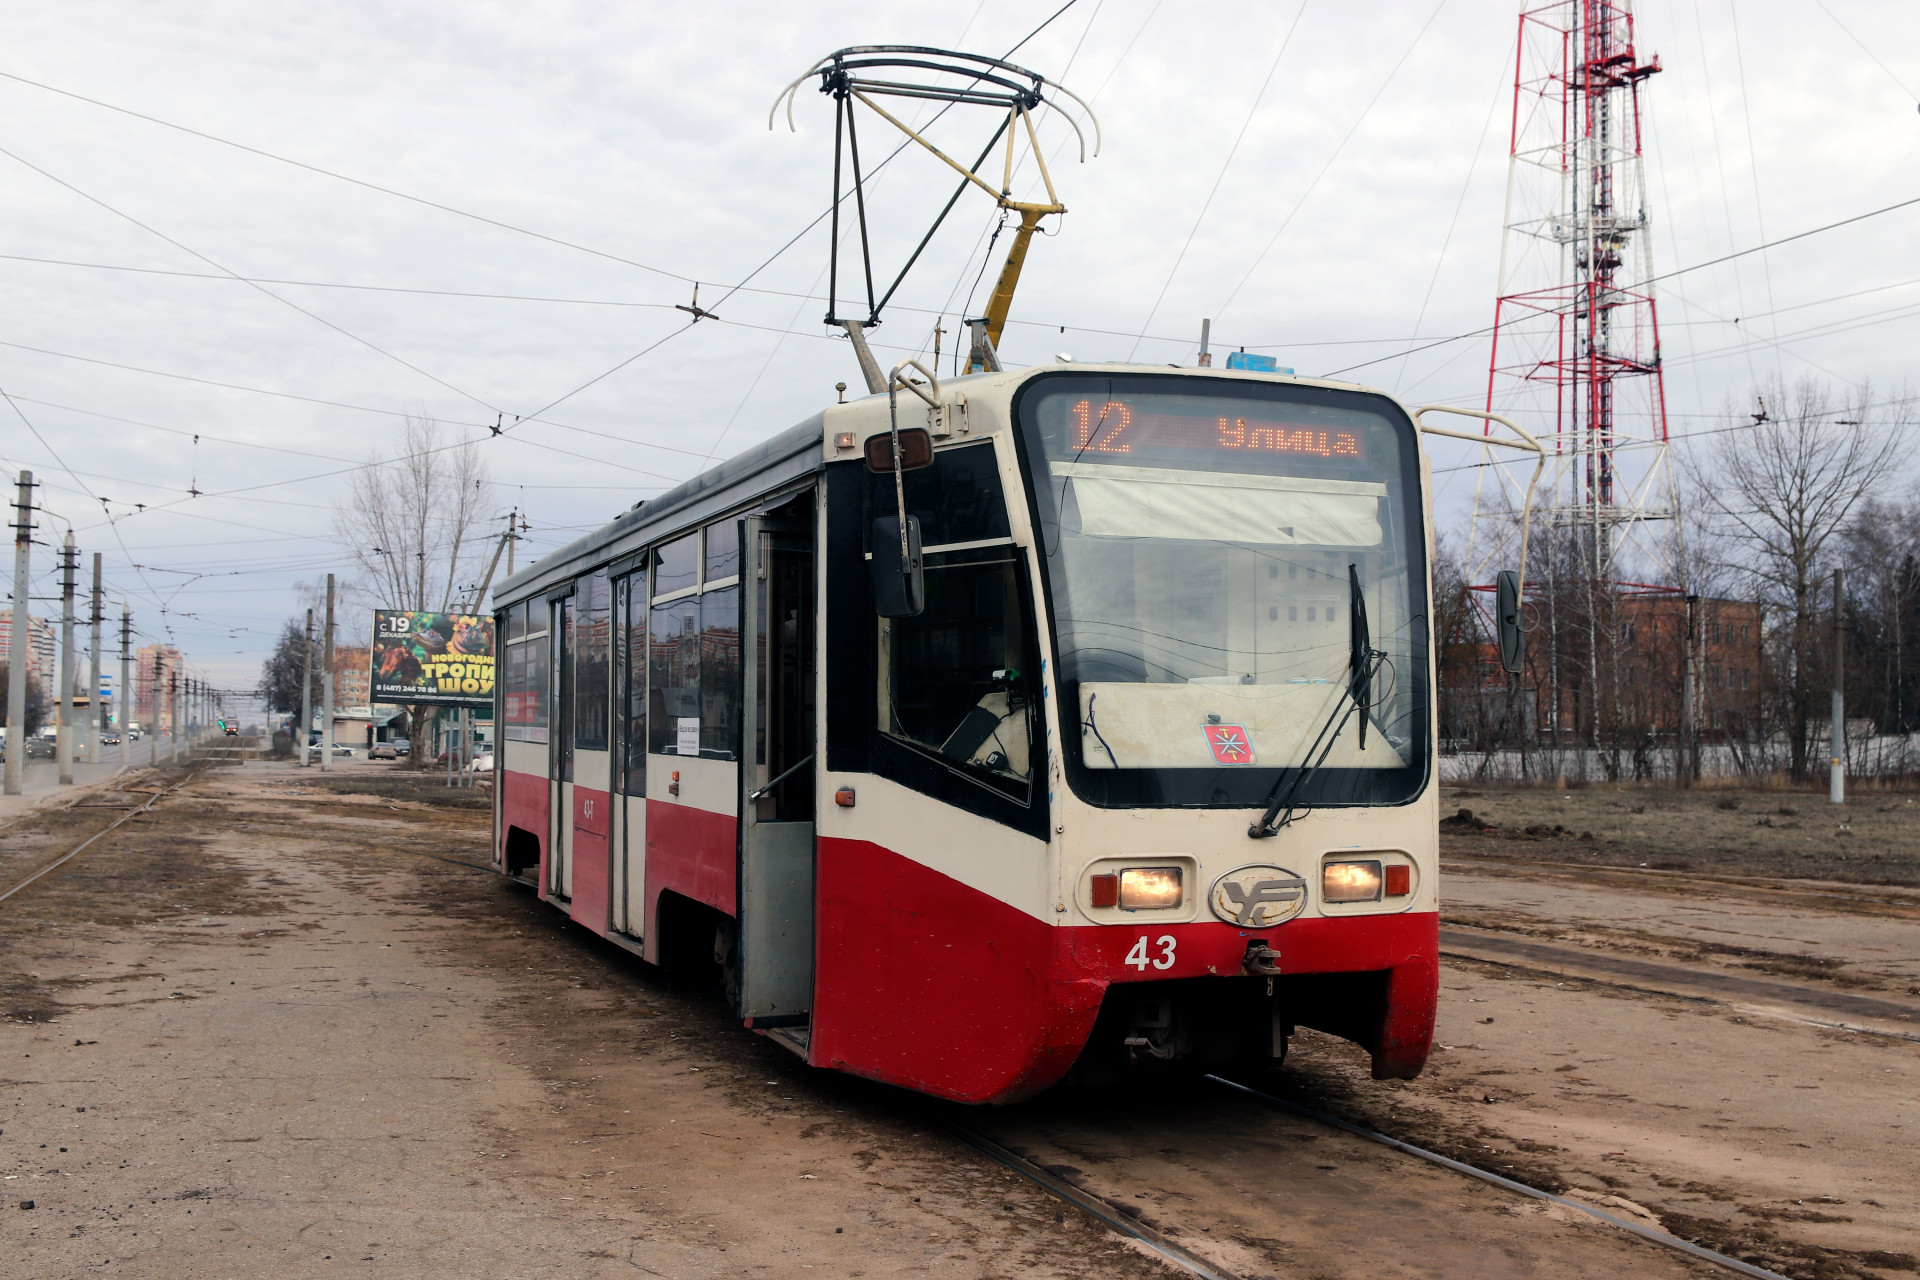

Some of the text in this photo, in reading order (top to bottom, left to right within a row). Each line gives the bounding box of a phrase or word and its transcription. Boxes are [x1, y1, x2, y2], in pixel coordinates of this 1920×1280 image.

[1072, 399, 1359, 457] 12 Улица
[389, 616, 410, 632] 19
[402, 685, 417, 693] 246
[437, 678, 494, 695] ШОУ
[1124, 934, 1177, 971] 43
